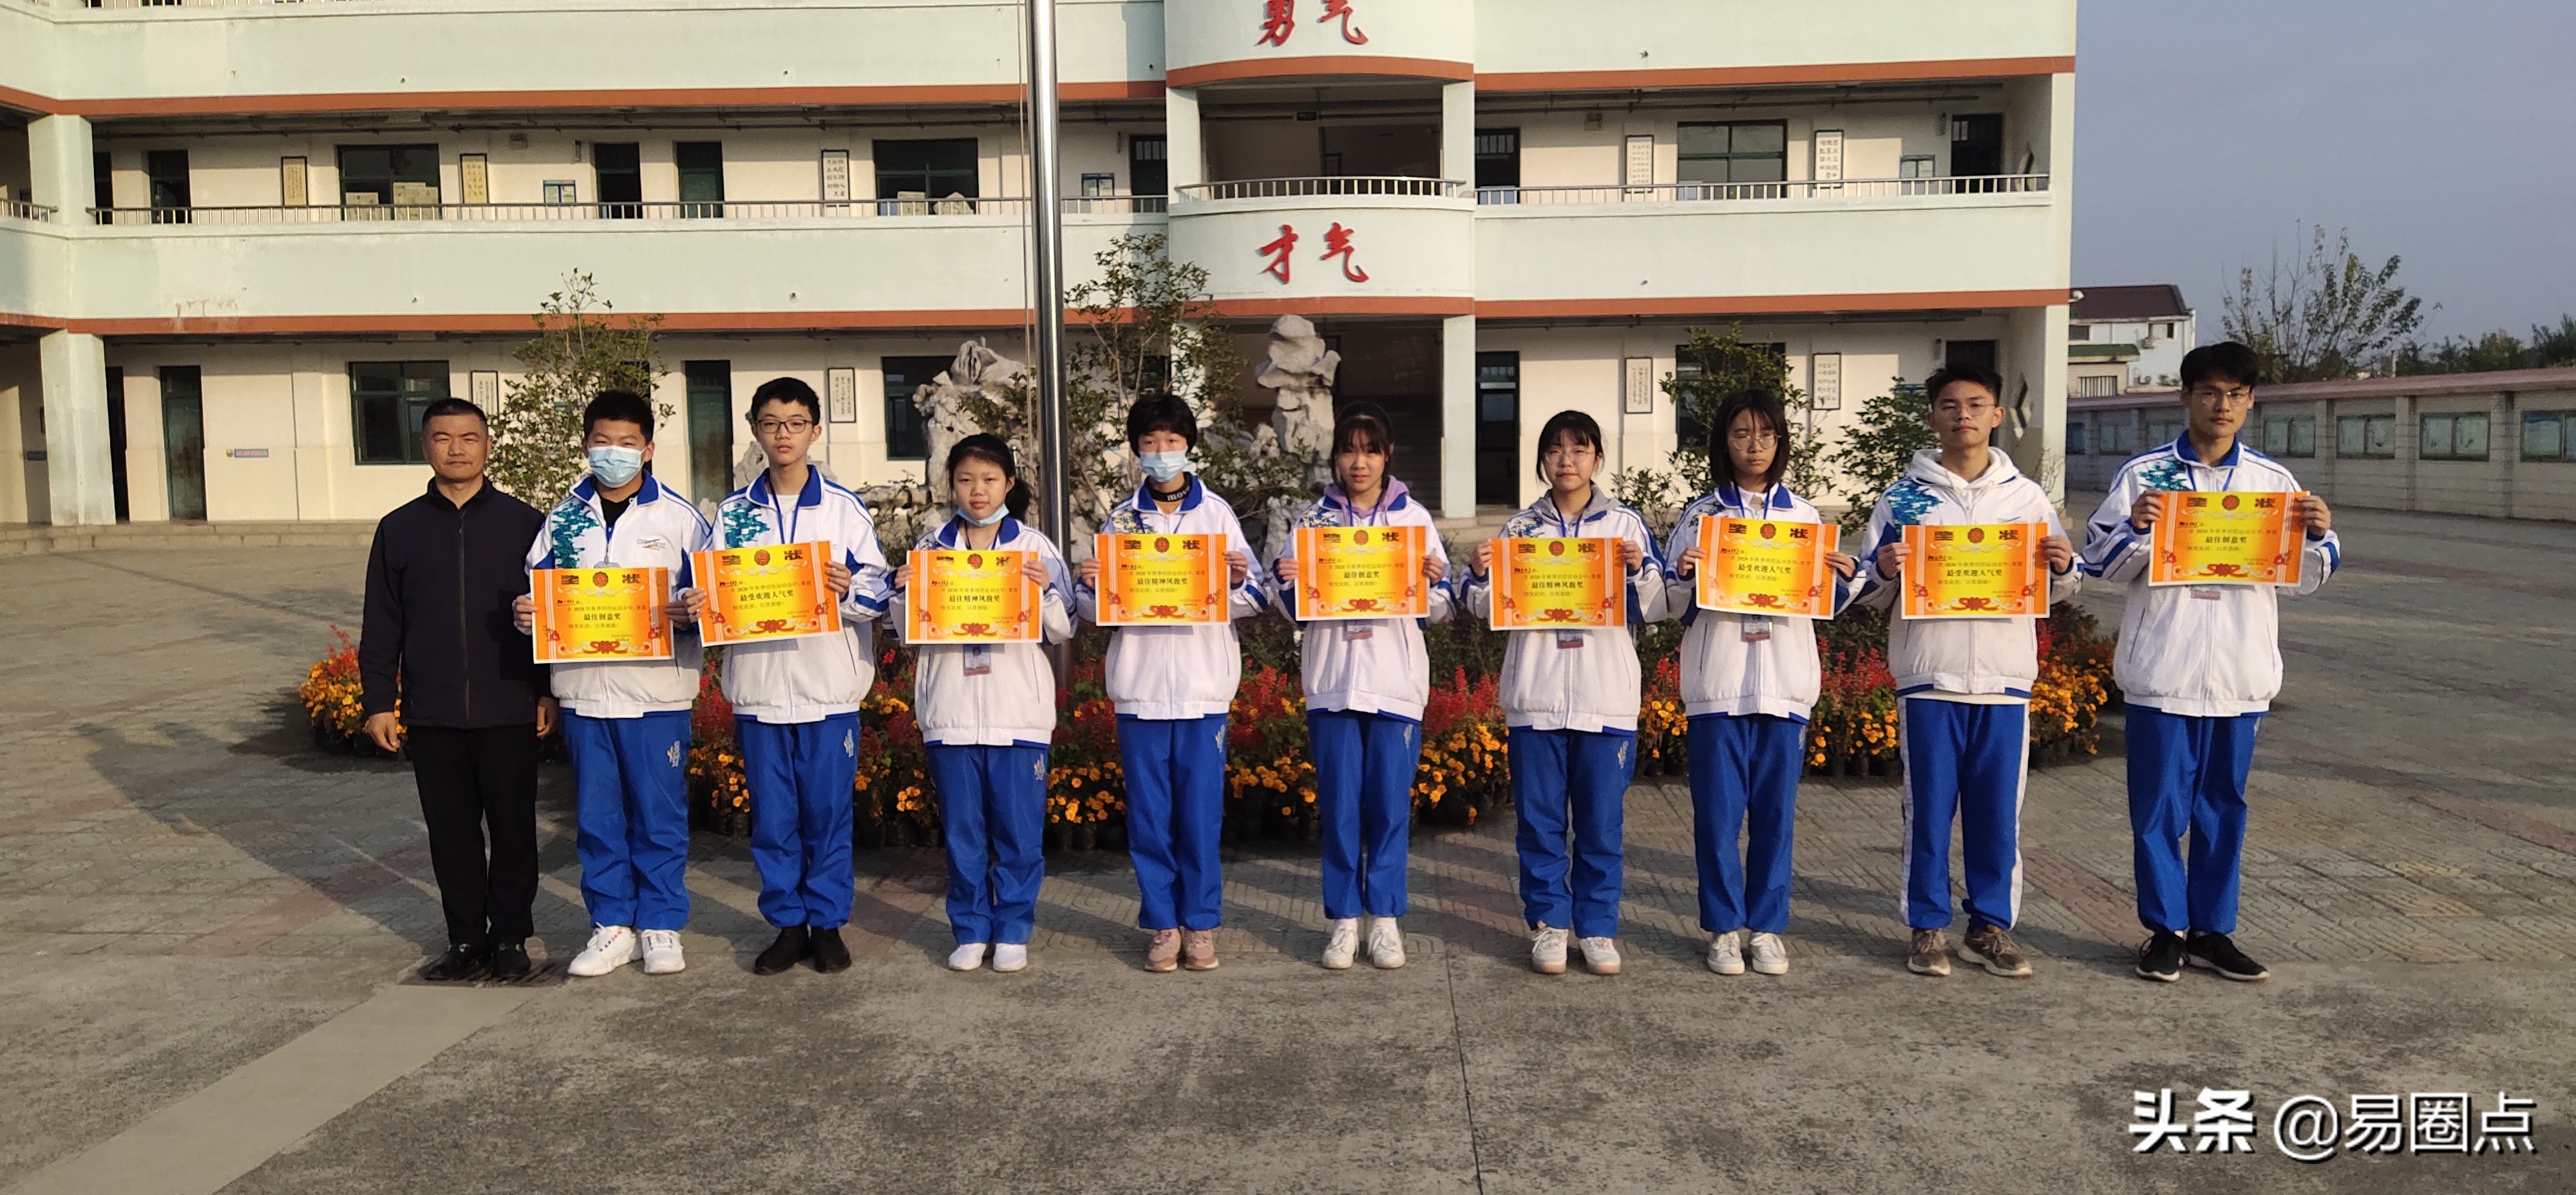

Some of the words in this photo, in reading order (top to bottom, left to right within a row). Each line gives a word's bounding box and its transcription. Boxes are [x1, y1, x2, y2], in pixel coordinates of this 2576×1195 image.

[1260, 222, 1369, 284] 才气
[1738, 564, 1791, 574] 最受欢迎人气奖
[740, 590, 793, 601] 最受欢迎人气奖
